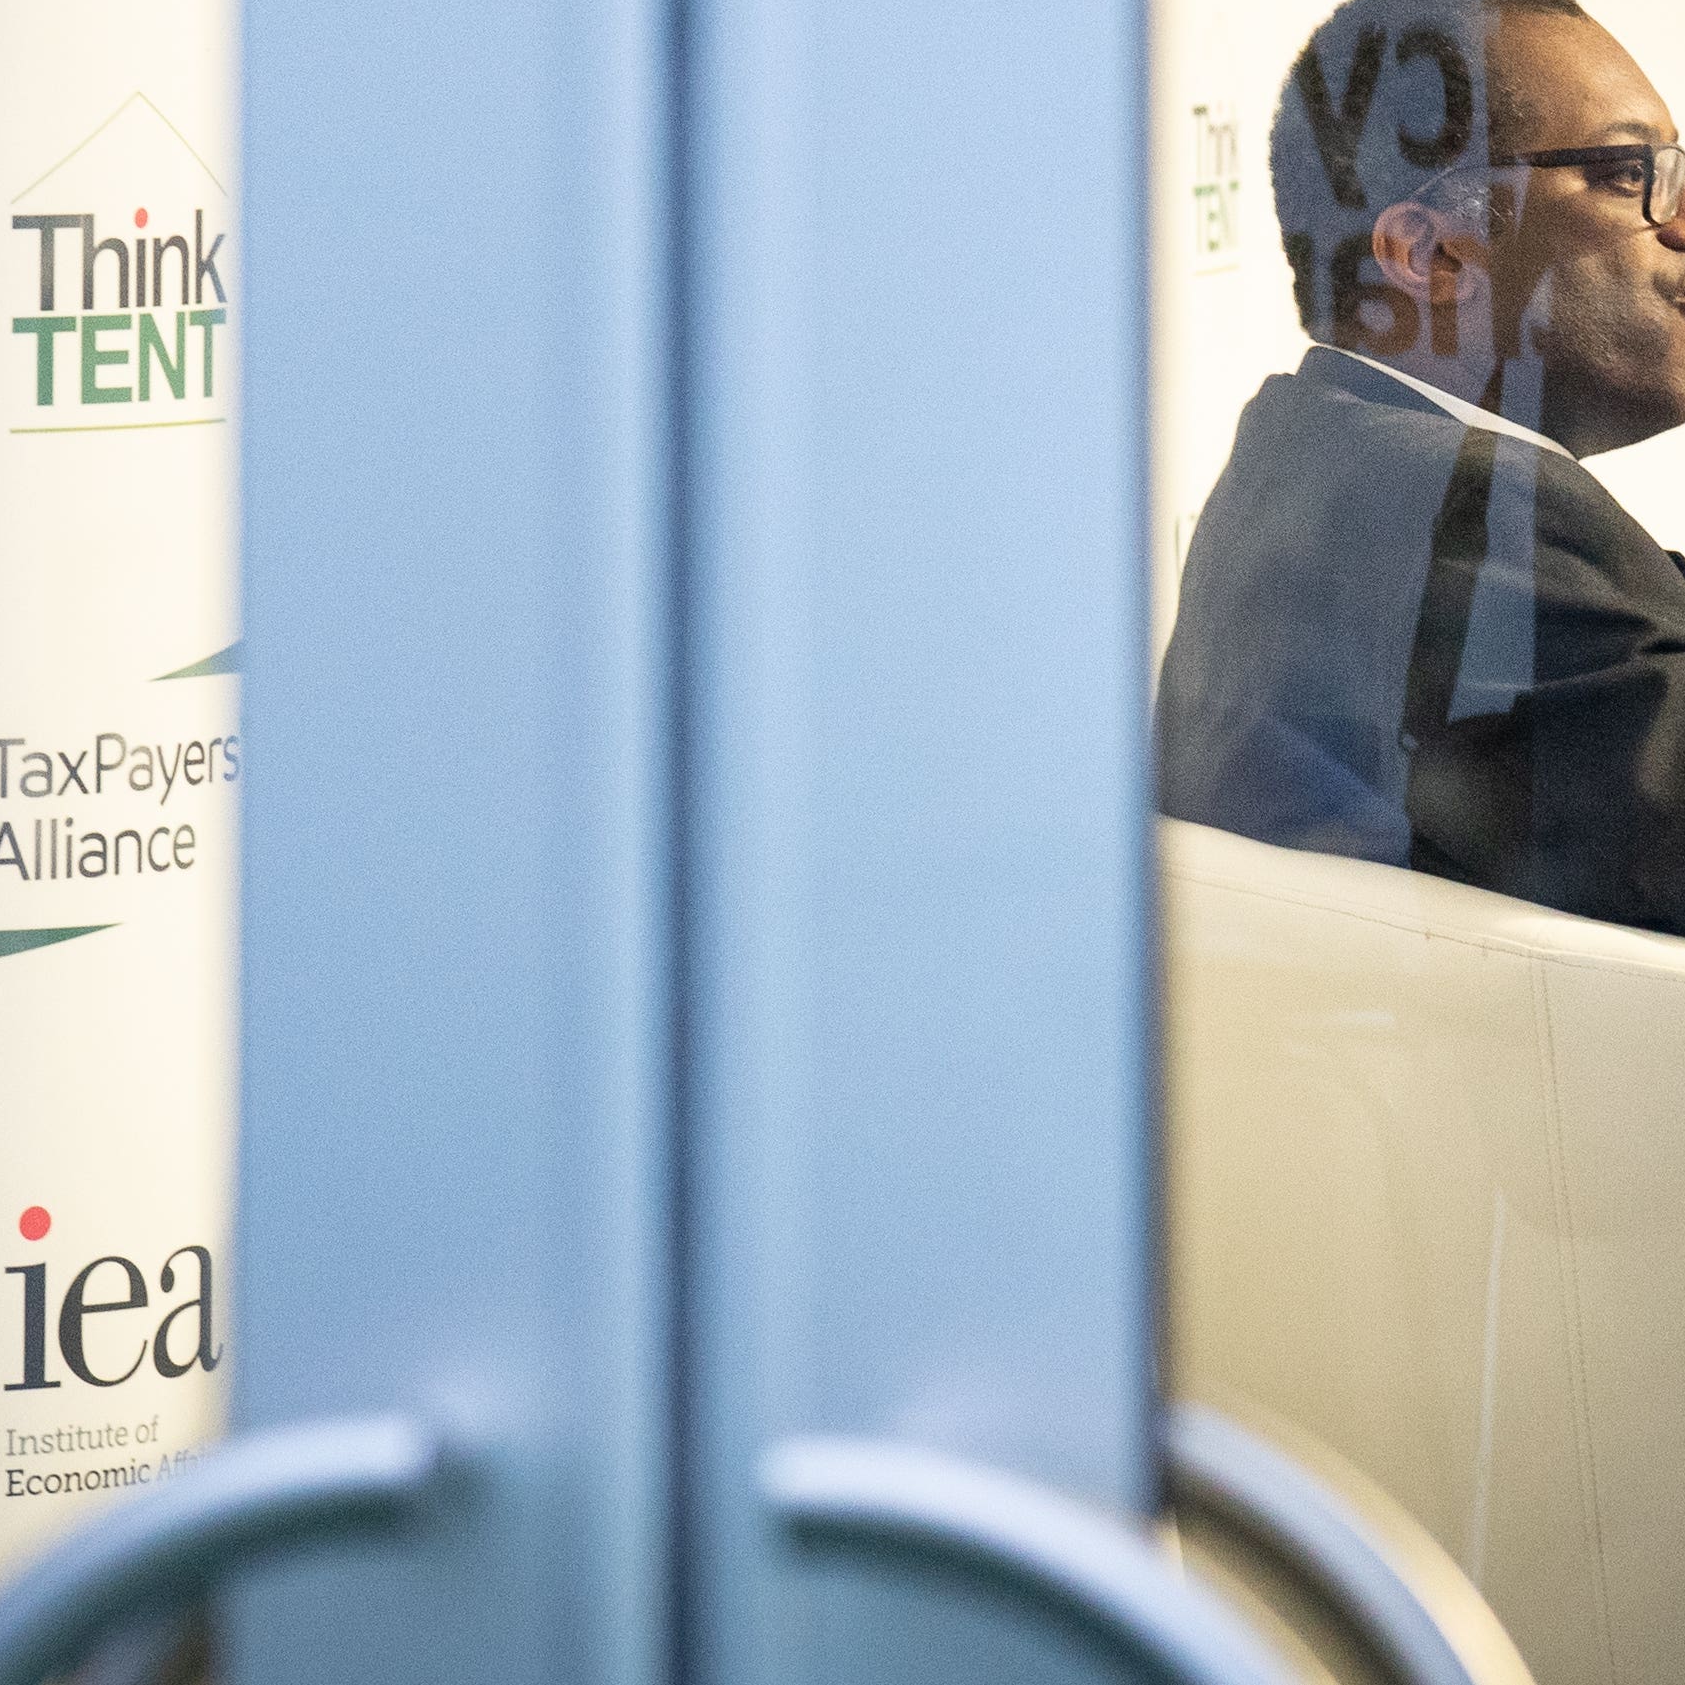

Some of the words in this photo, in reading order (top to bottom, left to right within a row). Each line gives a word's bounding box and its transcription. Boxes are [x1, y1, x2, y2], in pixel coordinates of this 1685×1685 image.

[11, 207, 228, 311] Think
[11, 308, 227, 407] TENT
[3, 1205, 225, 1392] iea
[6, 1424, 129, 1457] Institute
[134, 1414, 159, 1444] of
[6, 1457, 151, 1497] Economic
